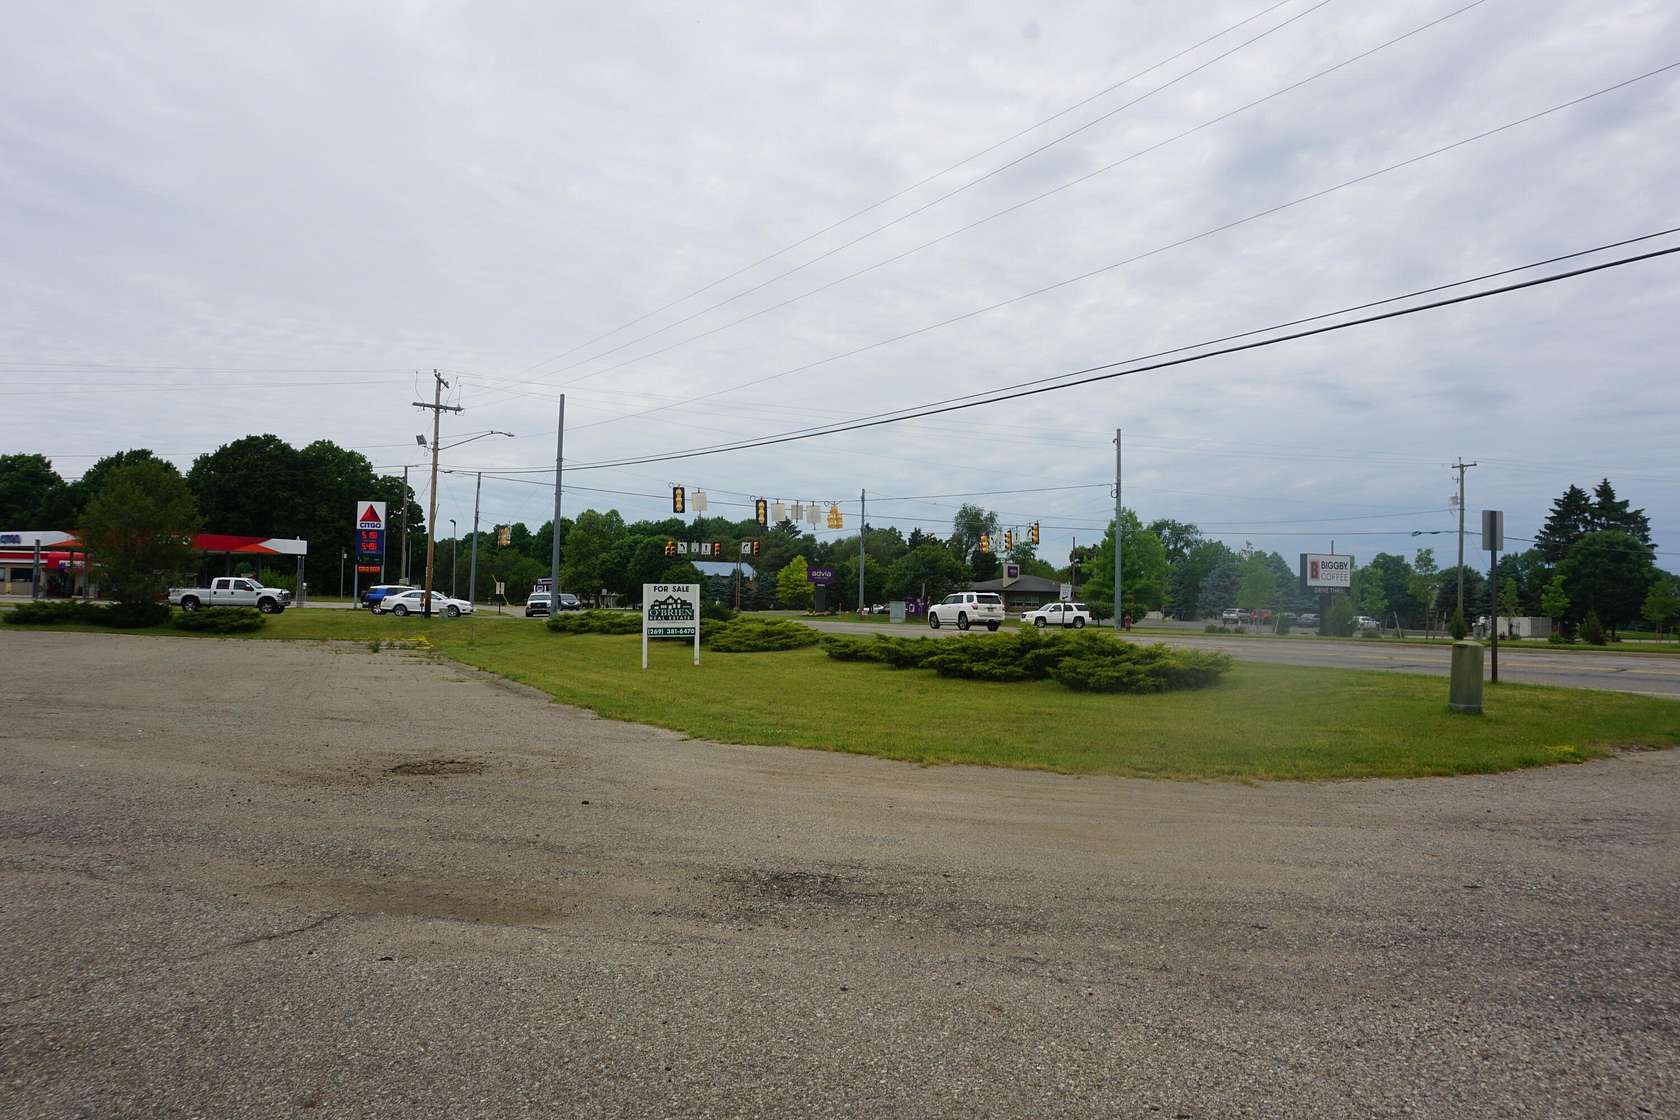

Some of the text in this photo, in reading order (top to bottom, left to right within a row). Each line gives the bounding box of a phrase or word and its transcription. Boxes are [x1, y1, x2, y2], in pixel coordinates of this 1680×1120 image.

[1320, 560, 1348, 570] BIGGBY
[811, 569, 832, 577] advia
[1320, 572, 1349, 581] COFFEE
[653, 585, 690, 593] FOR SALE
[649, 608, 693, 616] O'BRIEN
